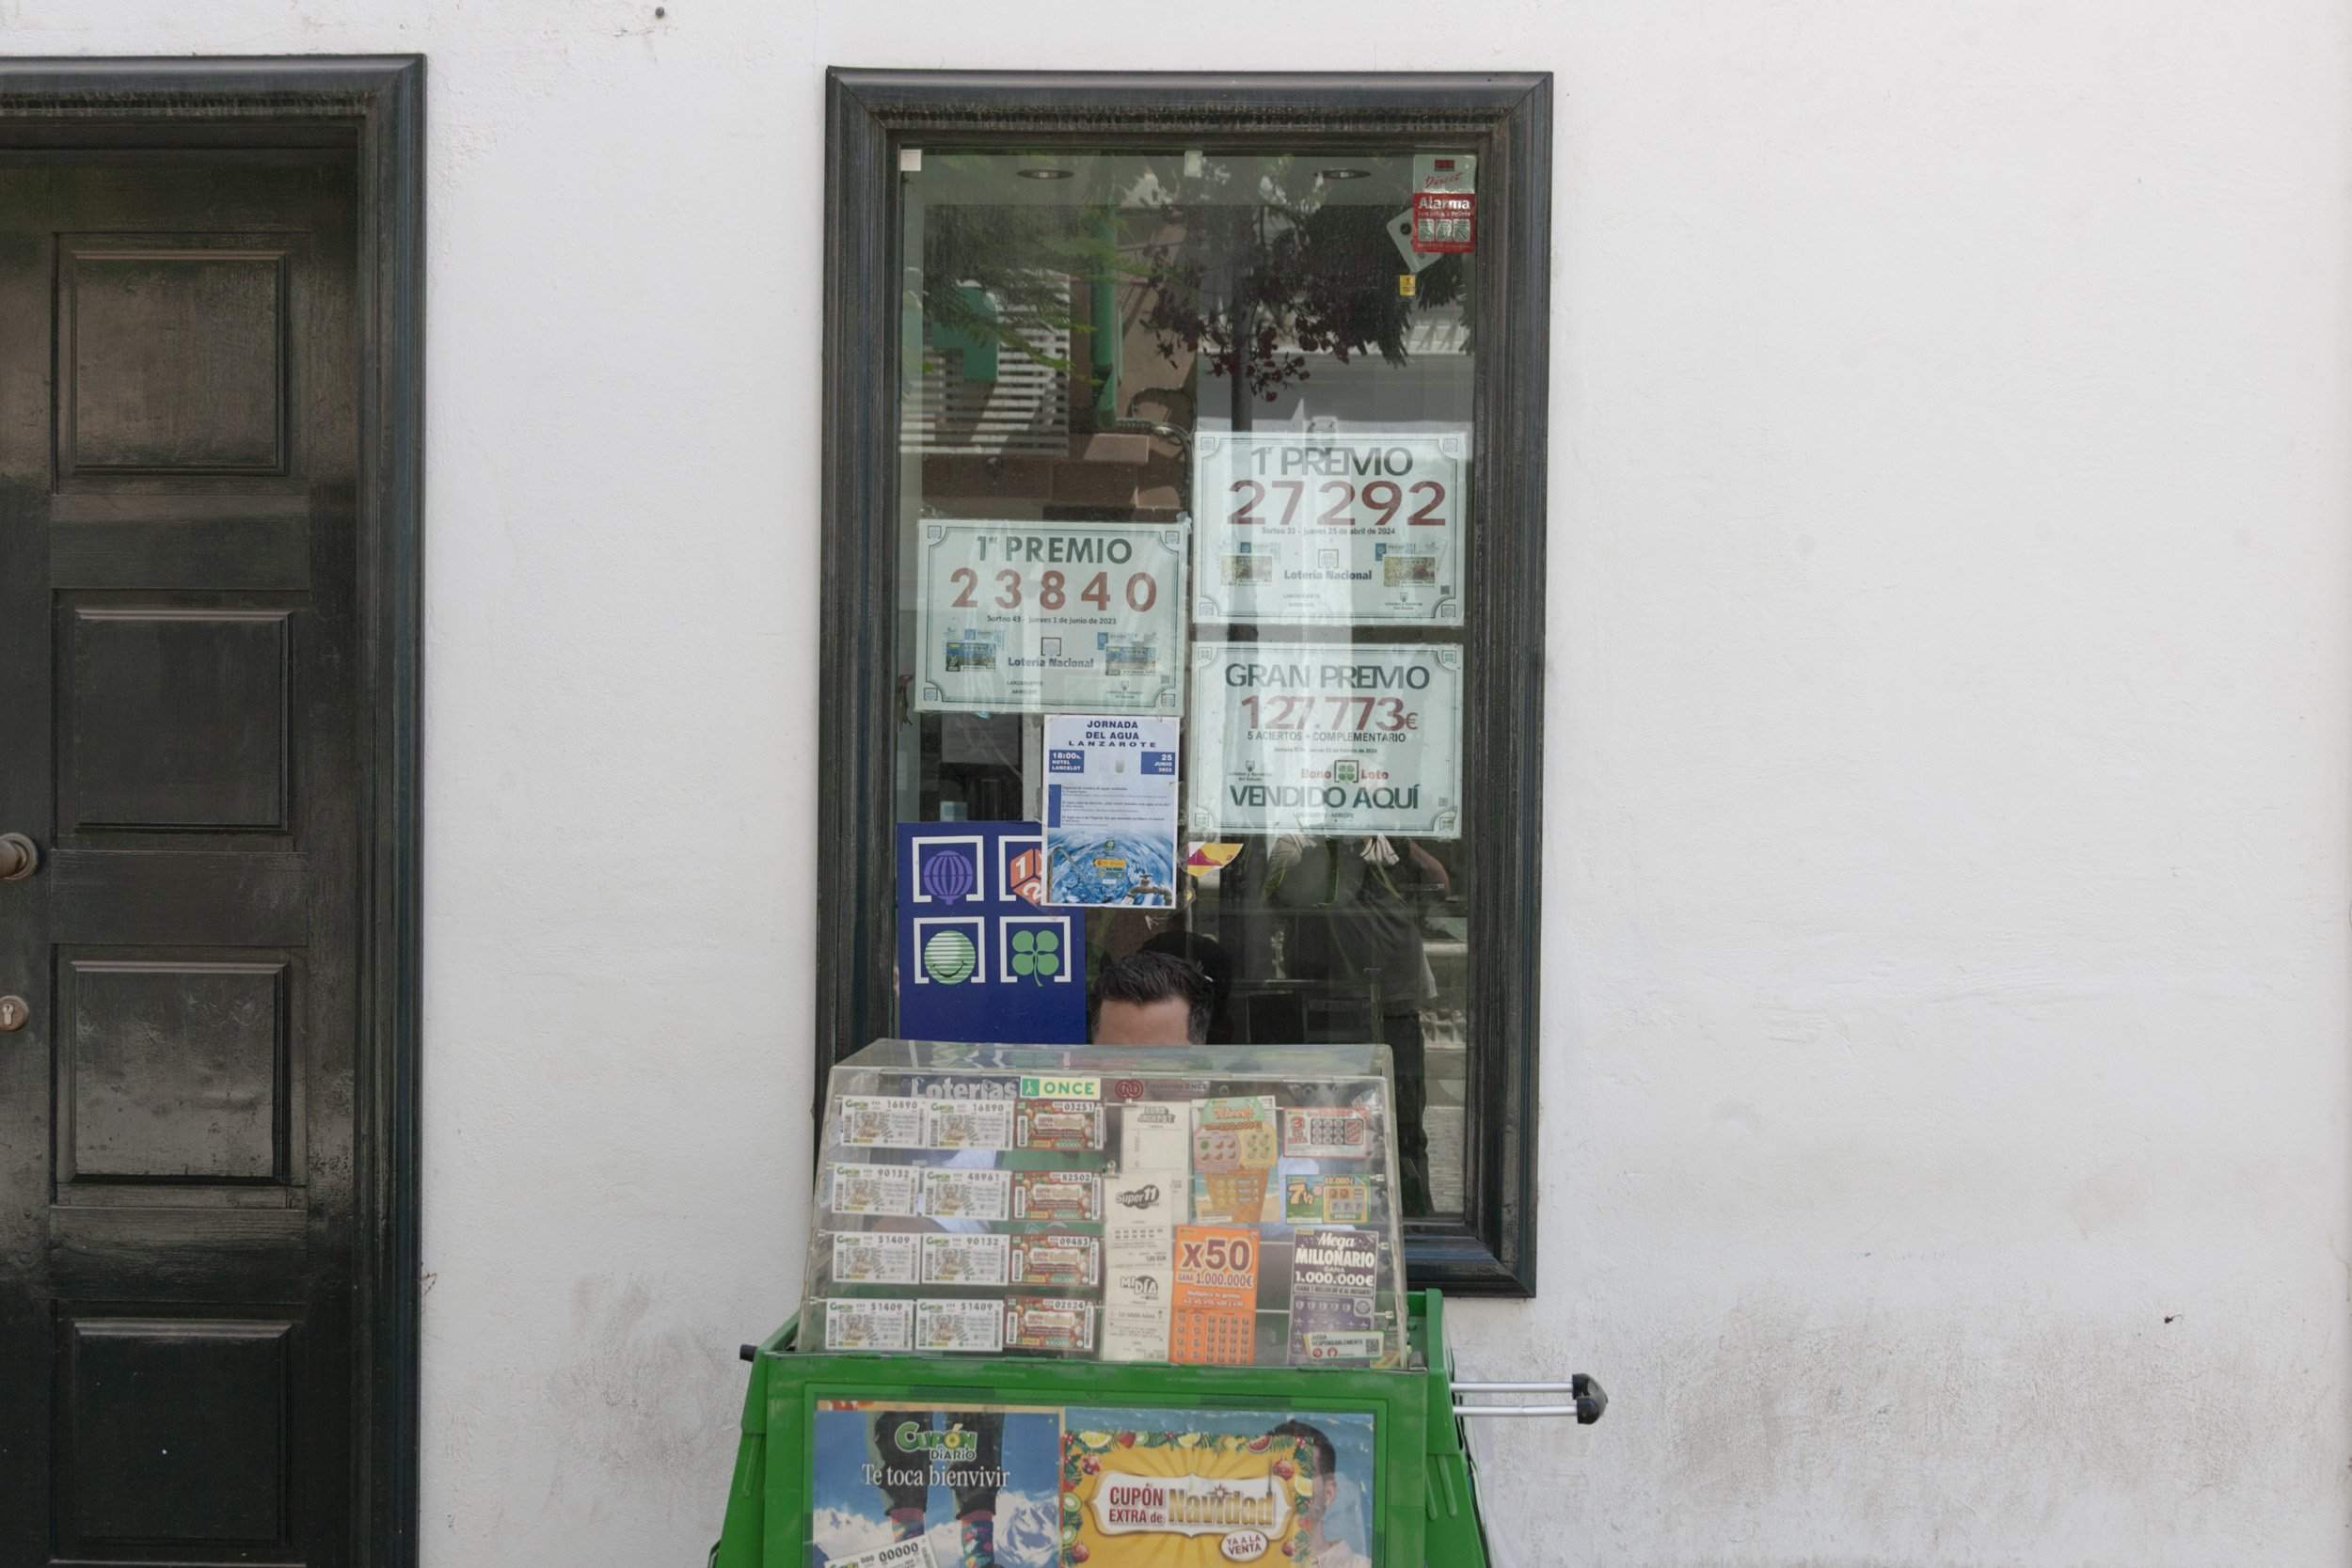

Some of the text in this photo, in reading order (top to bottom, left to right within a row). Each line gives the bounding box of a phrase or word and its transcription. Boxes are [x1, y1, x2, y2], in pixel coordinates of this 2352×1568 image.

[1419, 196, 1470, 210] Alarma
[1280, 447, 1413, 476] PREMIO
[1227, 480, 1446, 526] 27292
[1006, 537, 1133, 564] PREMIO
[1326, 570, 1372, 580] Nacional
[950, 567, 1157, 612] 23840
[1069, 617, 1087, 626] junio
[1048, 658, 1094, 668] Nacional
[1225, 663, 1430, 689] GRAN PREMIO
[1087, 721, 1138, 729] JORNADA
[1109, 732, 1139, 740] AGUA
[1248, 732, 1253, 740] 5
[1256, 732, 1302, 741] ACIERTOS
[1312, 732, 1406, 742] COMPLEMENTARIO
[1302, 768, 1389, 780] Bono Loto
[1229, 784, 1420, 810] VENDIDO AQUÍ
[1044, 1082, 1094, 1096] ONCE
[1317, 1232, 1356, 1250] Mega
[1182, 1239, 1250, 1271] x50
[1295, 1247, 1375, 1268] MILLONARIO
[1197, 1273, 1252, 1287] 1.000.000€
[1295, 1271, 1375, 1287] 1.000.000€
[862, 1464, 1010, 1488] Te toca bienvivir
[1109, 1482, 1275, 1526] CUPÓN Navidad
[1109, 1509, 1163, 1524] EXTRA de
[1227, 1537, 1239, 1545] YA
[1249, 1534, 1262, 1543] LA
[879, 1542, 919, 1562] 00000
[1228, 1543, 1262, 1555] VENTA
